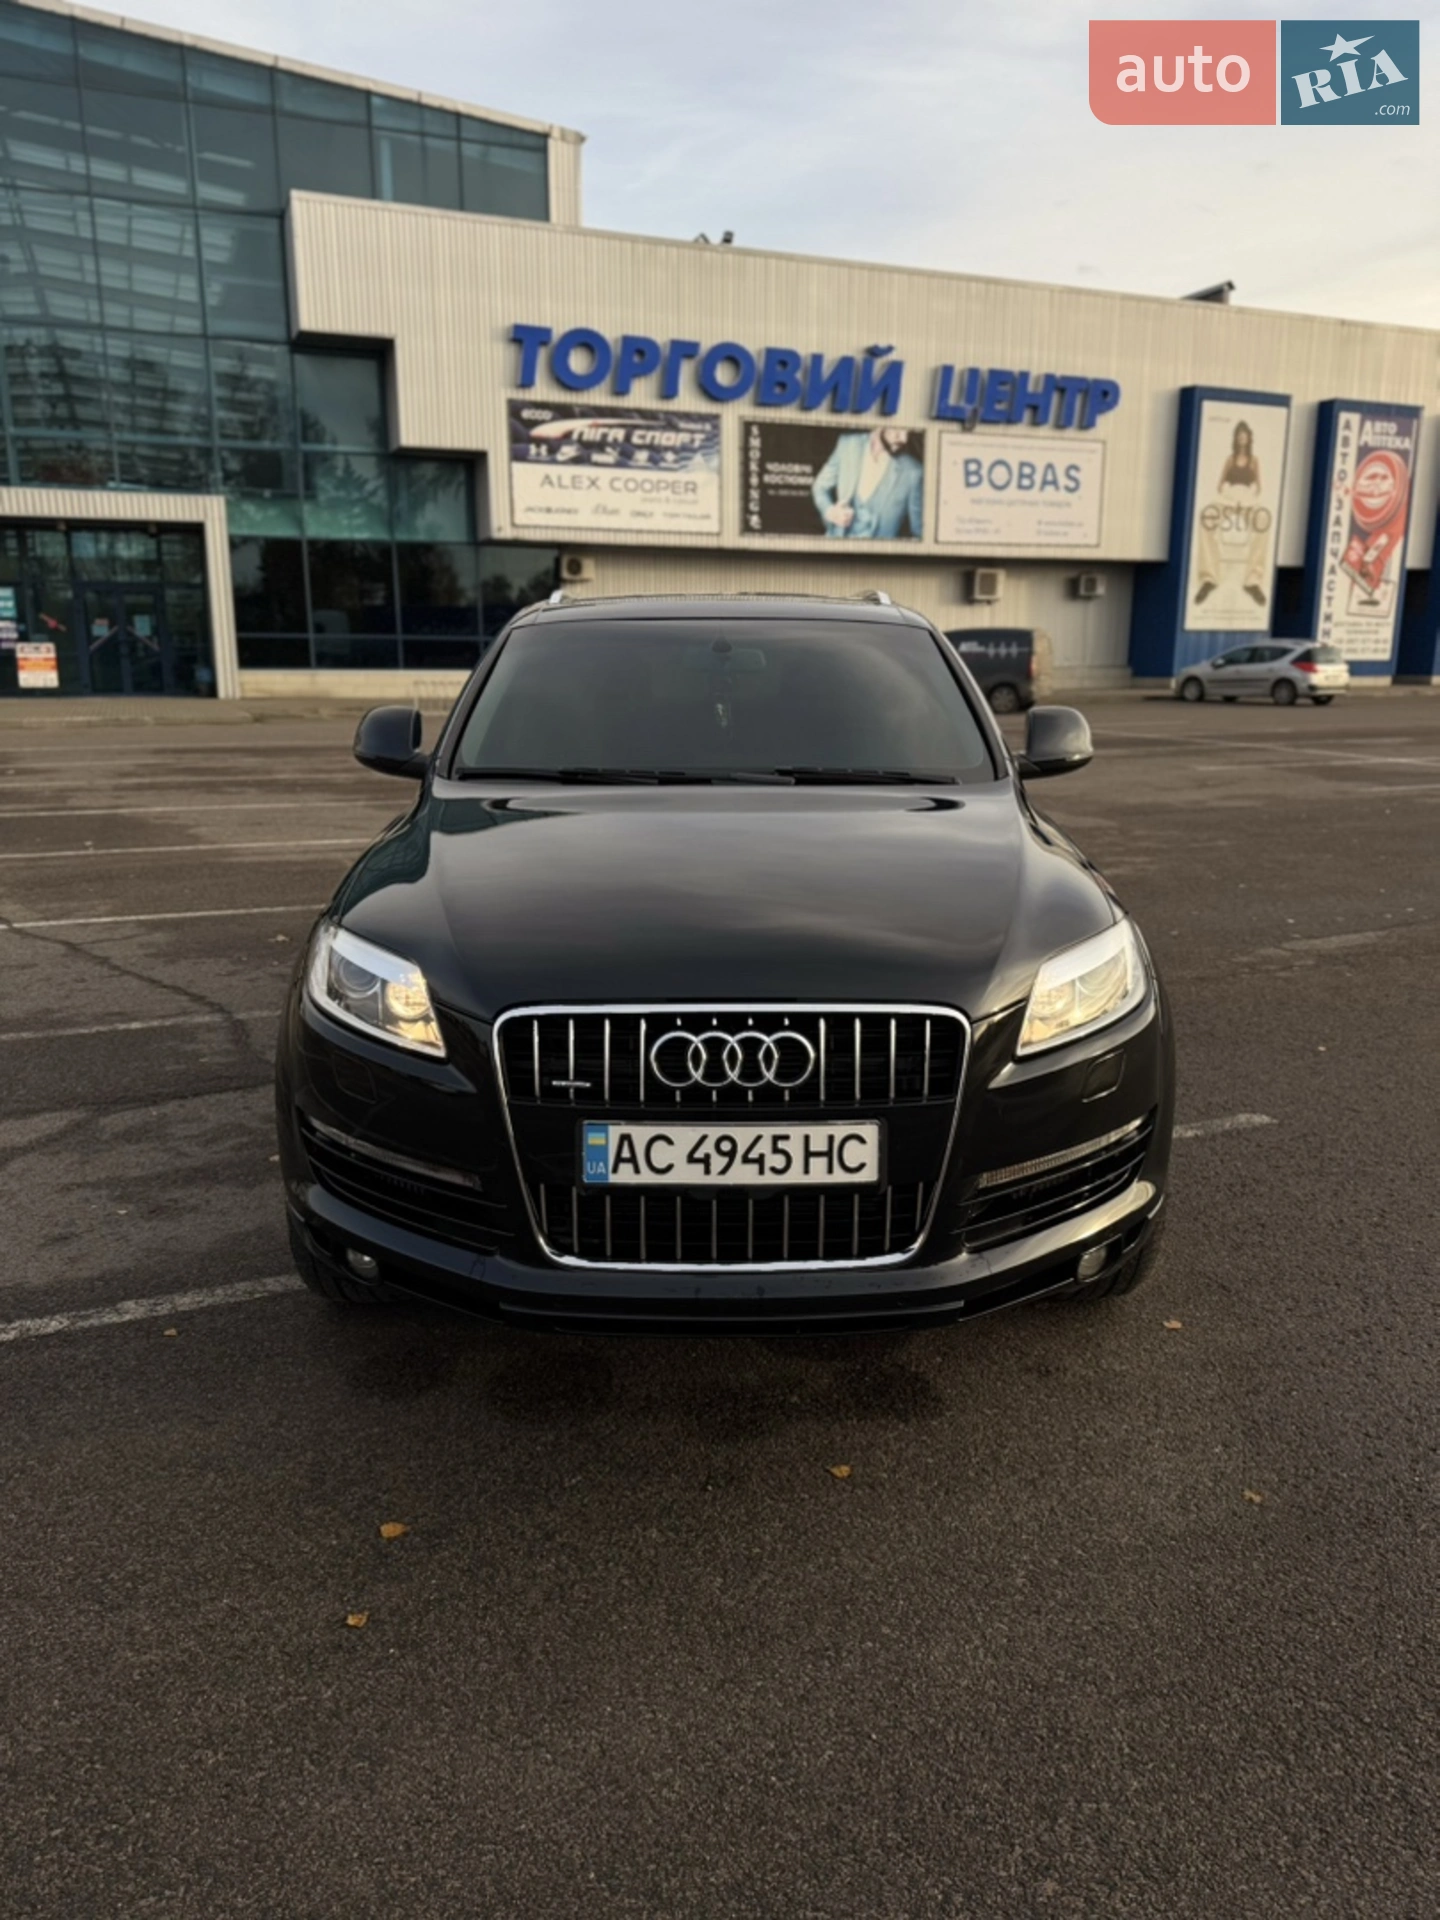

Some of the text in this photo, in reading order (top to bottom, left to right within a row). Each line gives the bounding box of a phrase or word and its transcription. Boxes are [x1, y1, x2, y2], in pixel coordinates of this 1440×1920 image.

[511, 323, 1121, 430] ТОРГОВИЙ ЦЕНТР
[540, 474, 699, 496] ALEX COOPER
[963, 458, 1081, 494] BOBAS
[1200, 501, 1272, 534] estro
[587, 1161, 607, 1175] UA
[611, 1133, 868, 1176] AC 4945 HC
